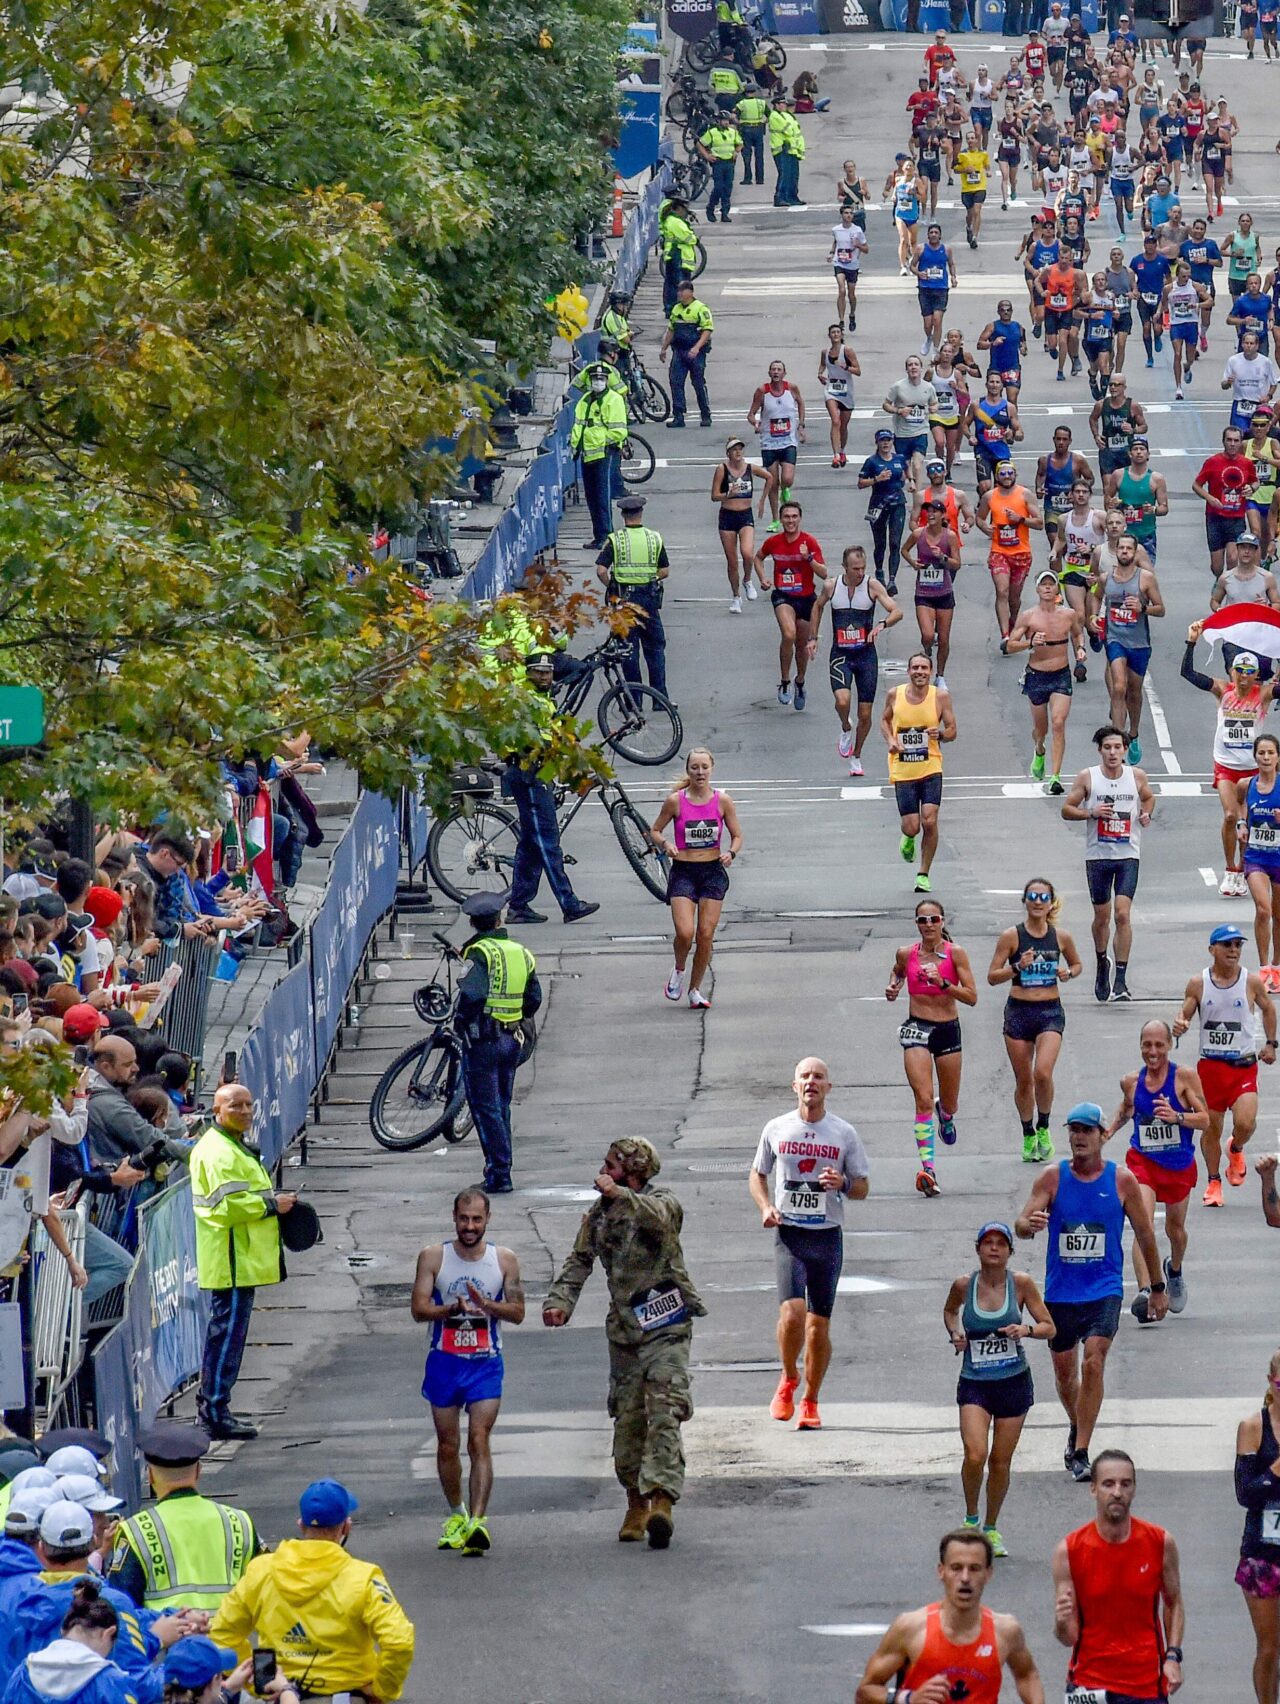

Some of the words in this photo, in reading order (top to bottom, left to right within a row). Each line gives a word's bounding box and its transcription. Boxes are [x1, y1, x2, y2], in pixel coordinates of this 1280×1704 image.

[902, 733, 923, 746] 6839
[1228, 727, 1249, 740] 6014
[902, 753, 925, 763] Mike
[691, 827, 714, 839] 6082
[1210, 1031, 1235, 1046] 5587
[1144, 1124, 1173, 1142] 4910
[778, 1140, 841, 1162] WISCONSIN
[789, 1192, 819, 1210] 4795
[1066, 1234, 1097, 1251] 6577
[640, 1295, 678, 1323] 24009
[977, 1339, 1009, 1356] 7226
[138, 1513, 166, 1577] BOSTON
[225, 1506, 243, 1571] POLICE
